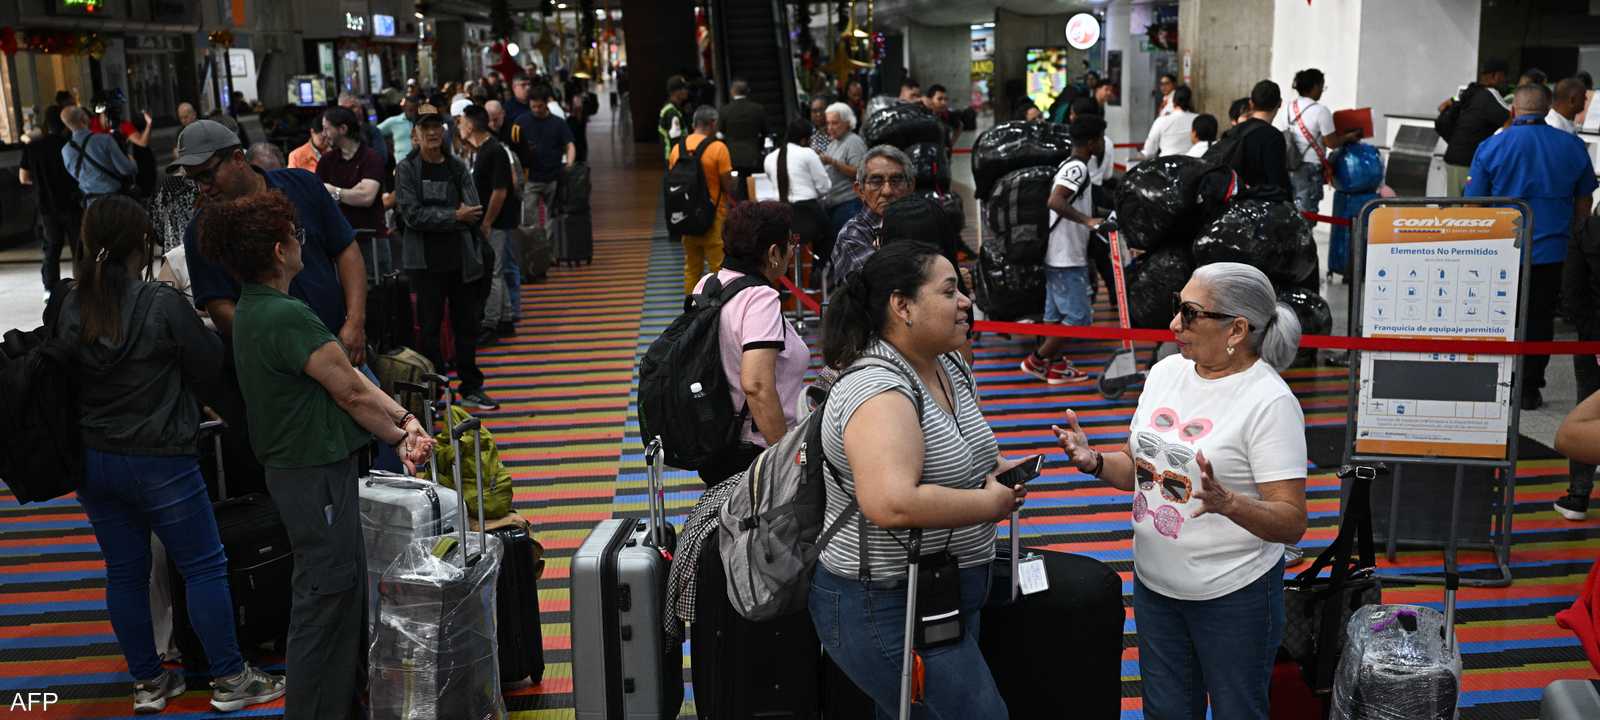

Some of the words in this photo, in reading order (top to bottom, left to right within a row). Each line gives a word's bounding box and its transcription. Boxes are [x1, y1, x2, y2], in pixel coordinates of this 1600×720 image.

[1390, 247, 1435, 255] Elementos
[1451, 247, 1498, 256] Permitidos
[1374, 324, 1415, 333] Franquicia
[1428, 325, 1463, 334] equipaje
[1465, 325, 1505, 334] permitido
